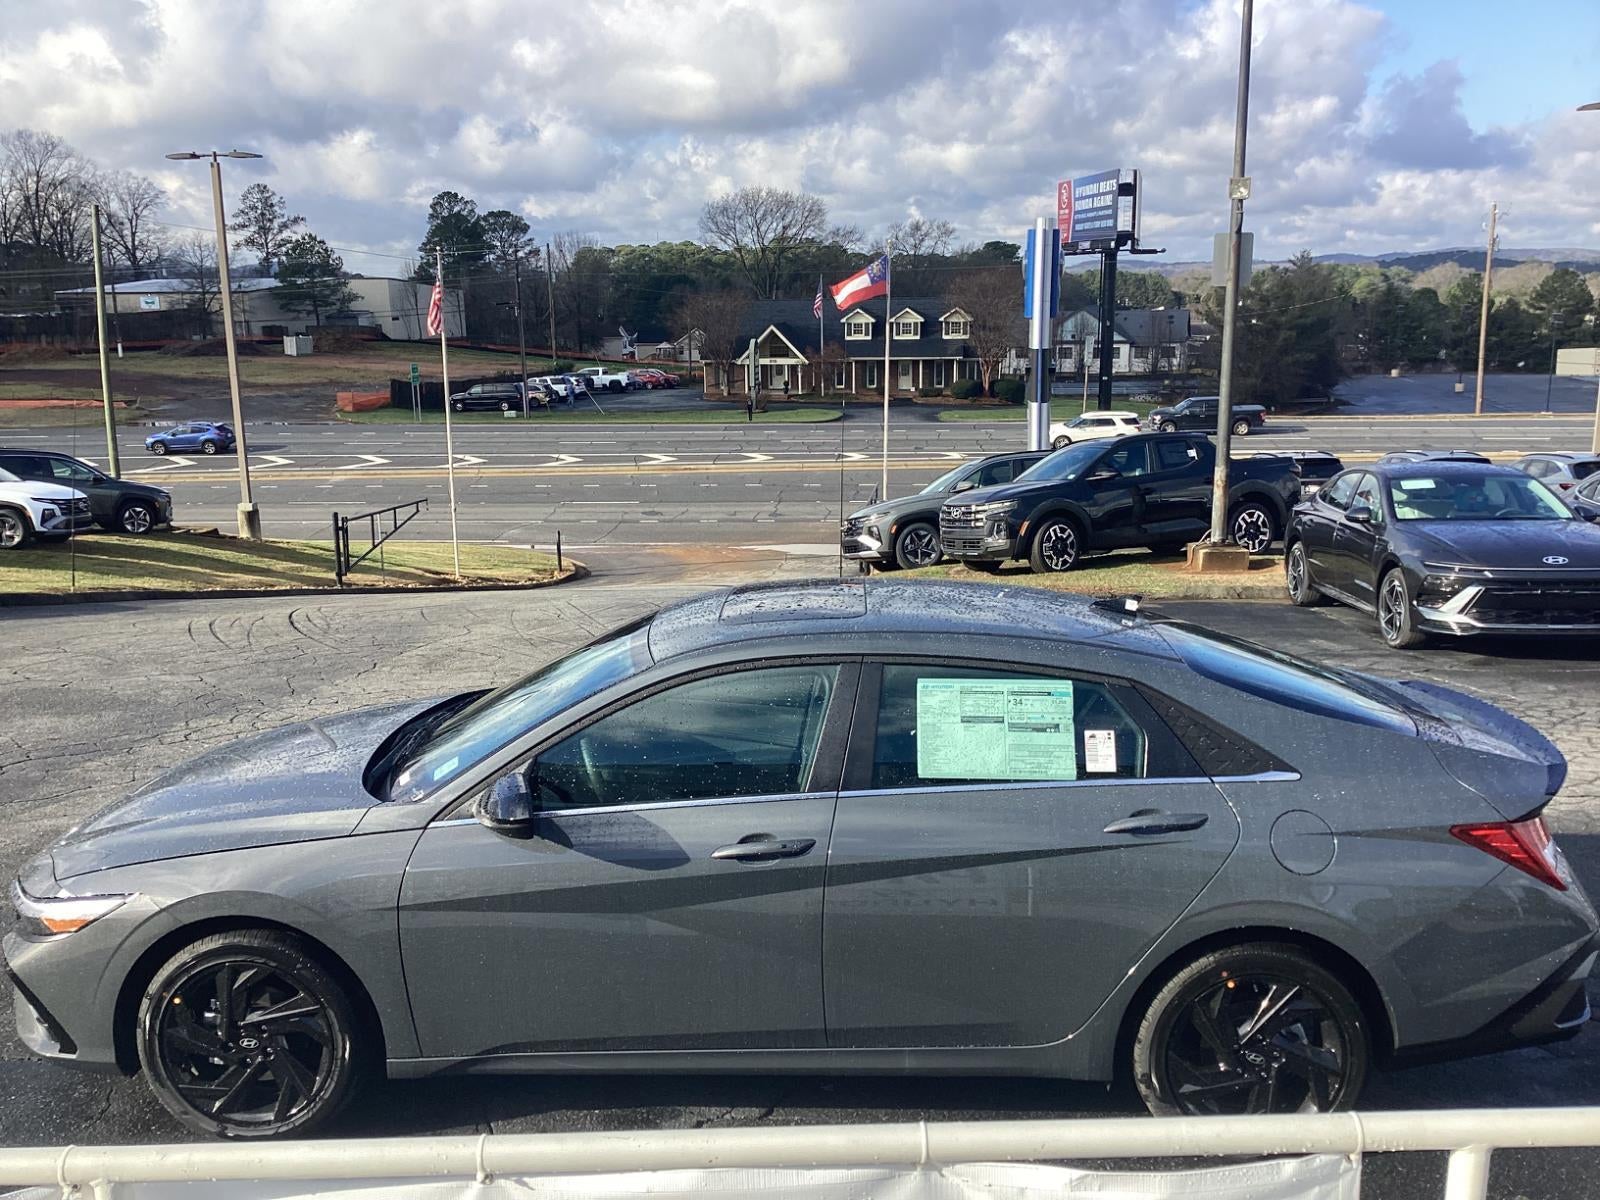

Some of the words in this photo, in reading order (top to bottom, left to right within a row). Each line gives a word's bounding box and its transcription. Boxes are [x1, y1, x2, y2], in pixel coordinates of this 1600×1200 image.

[1075, 183, 1099, 198] HYUNDAI
[1099, 179, 1117, 193] BEATS
[1012, 698, 1023, 706] 34
